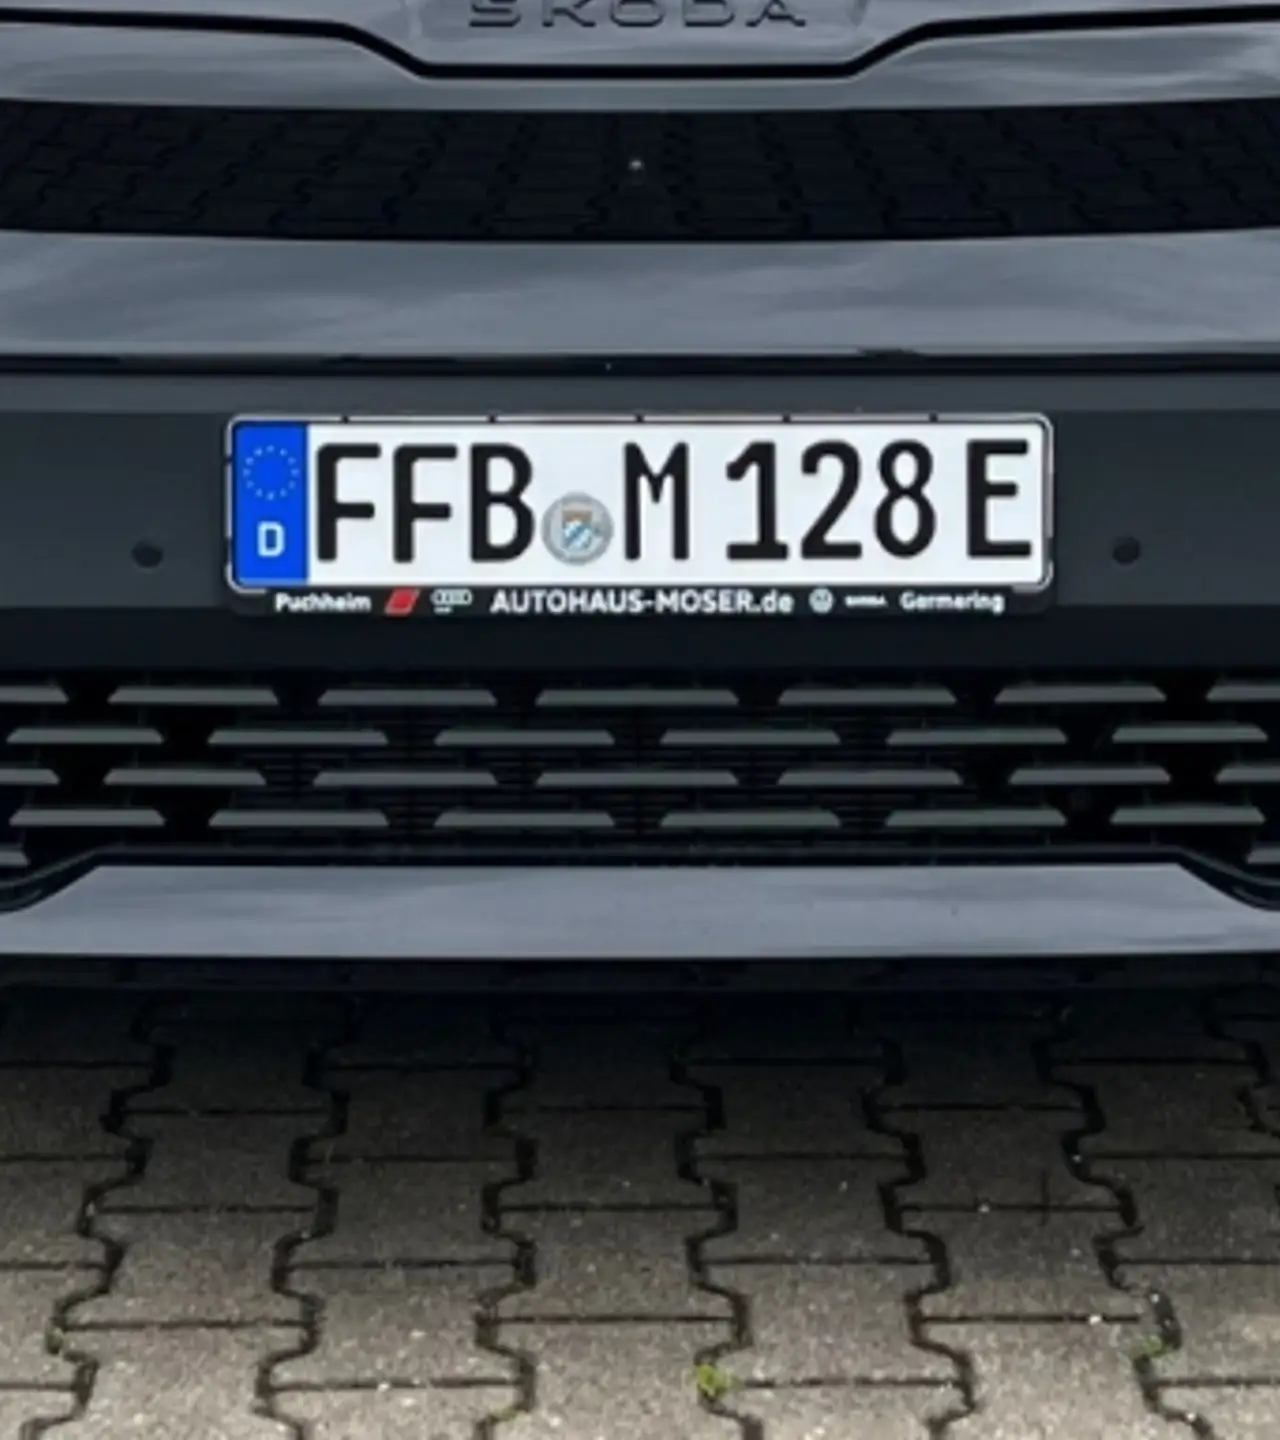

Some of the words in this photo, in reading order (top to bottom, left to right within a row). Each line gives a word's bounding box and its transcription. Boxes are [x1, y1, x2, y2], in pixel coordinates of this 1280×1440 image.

[314, 441, 536, 564] FFB
[623, 440, 690, 562] M
[256, 520, 286, 558] D
[274, 591, 372, 613] Puchheim
[489, 588, 796, 614] AUTOHAUS-MOSER.de
